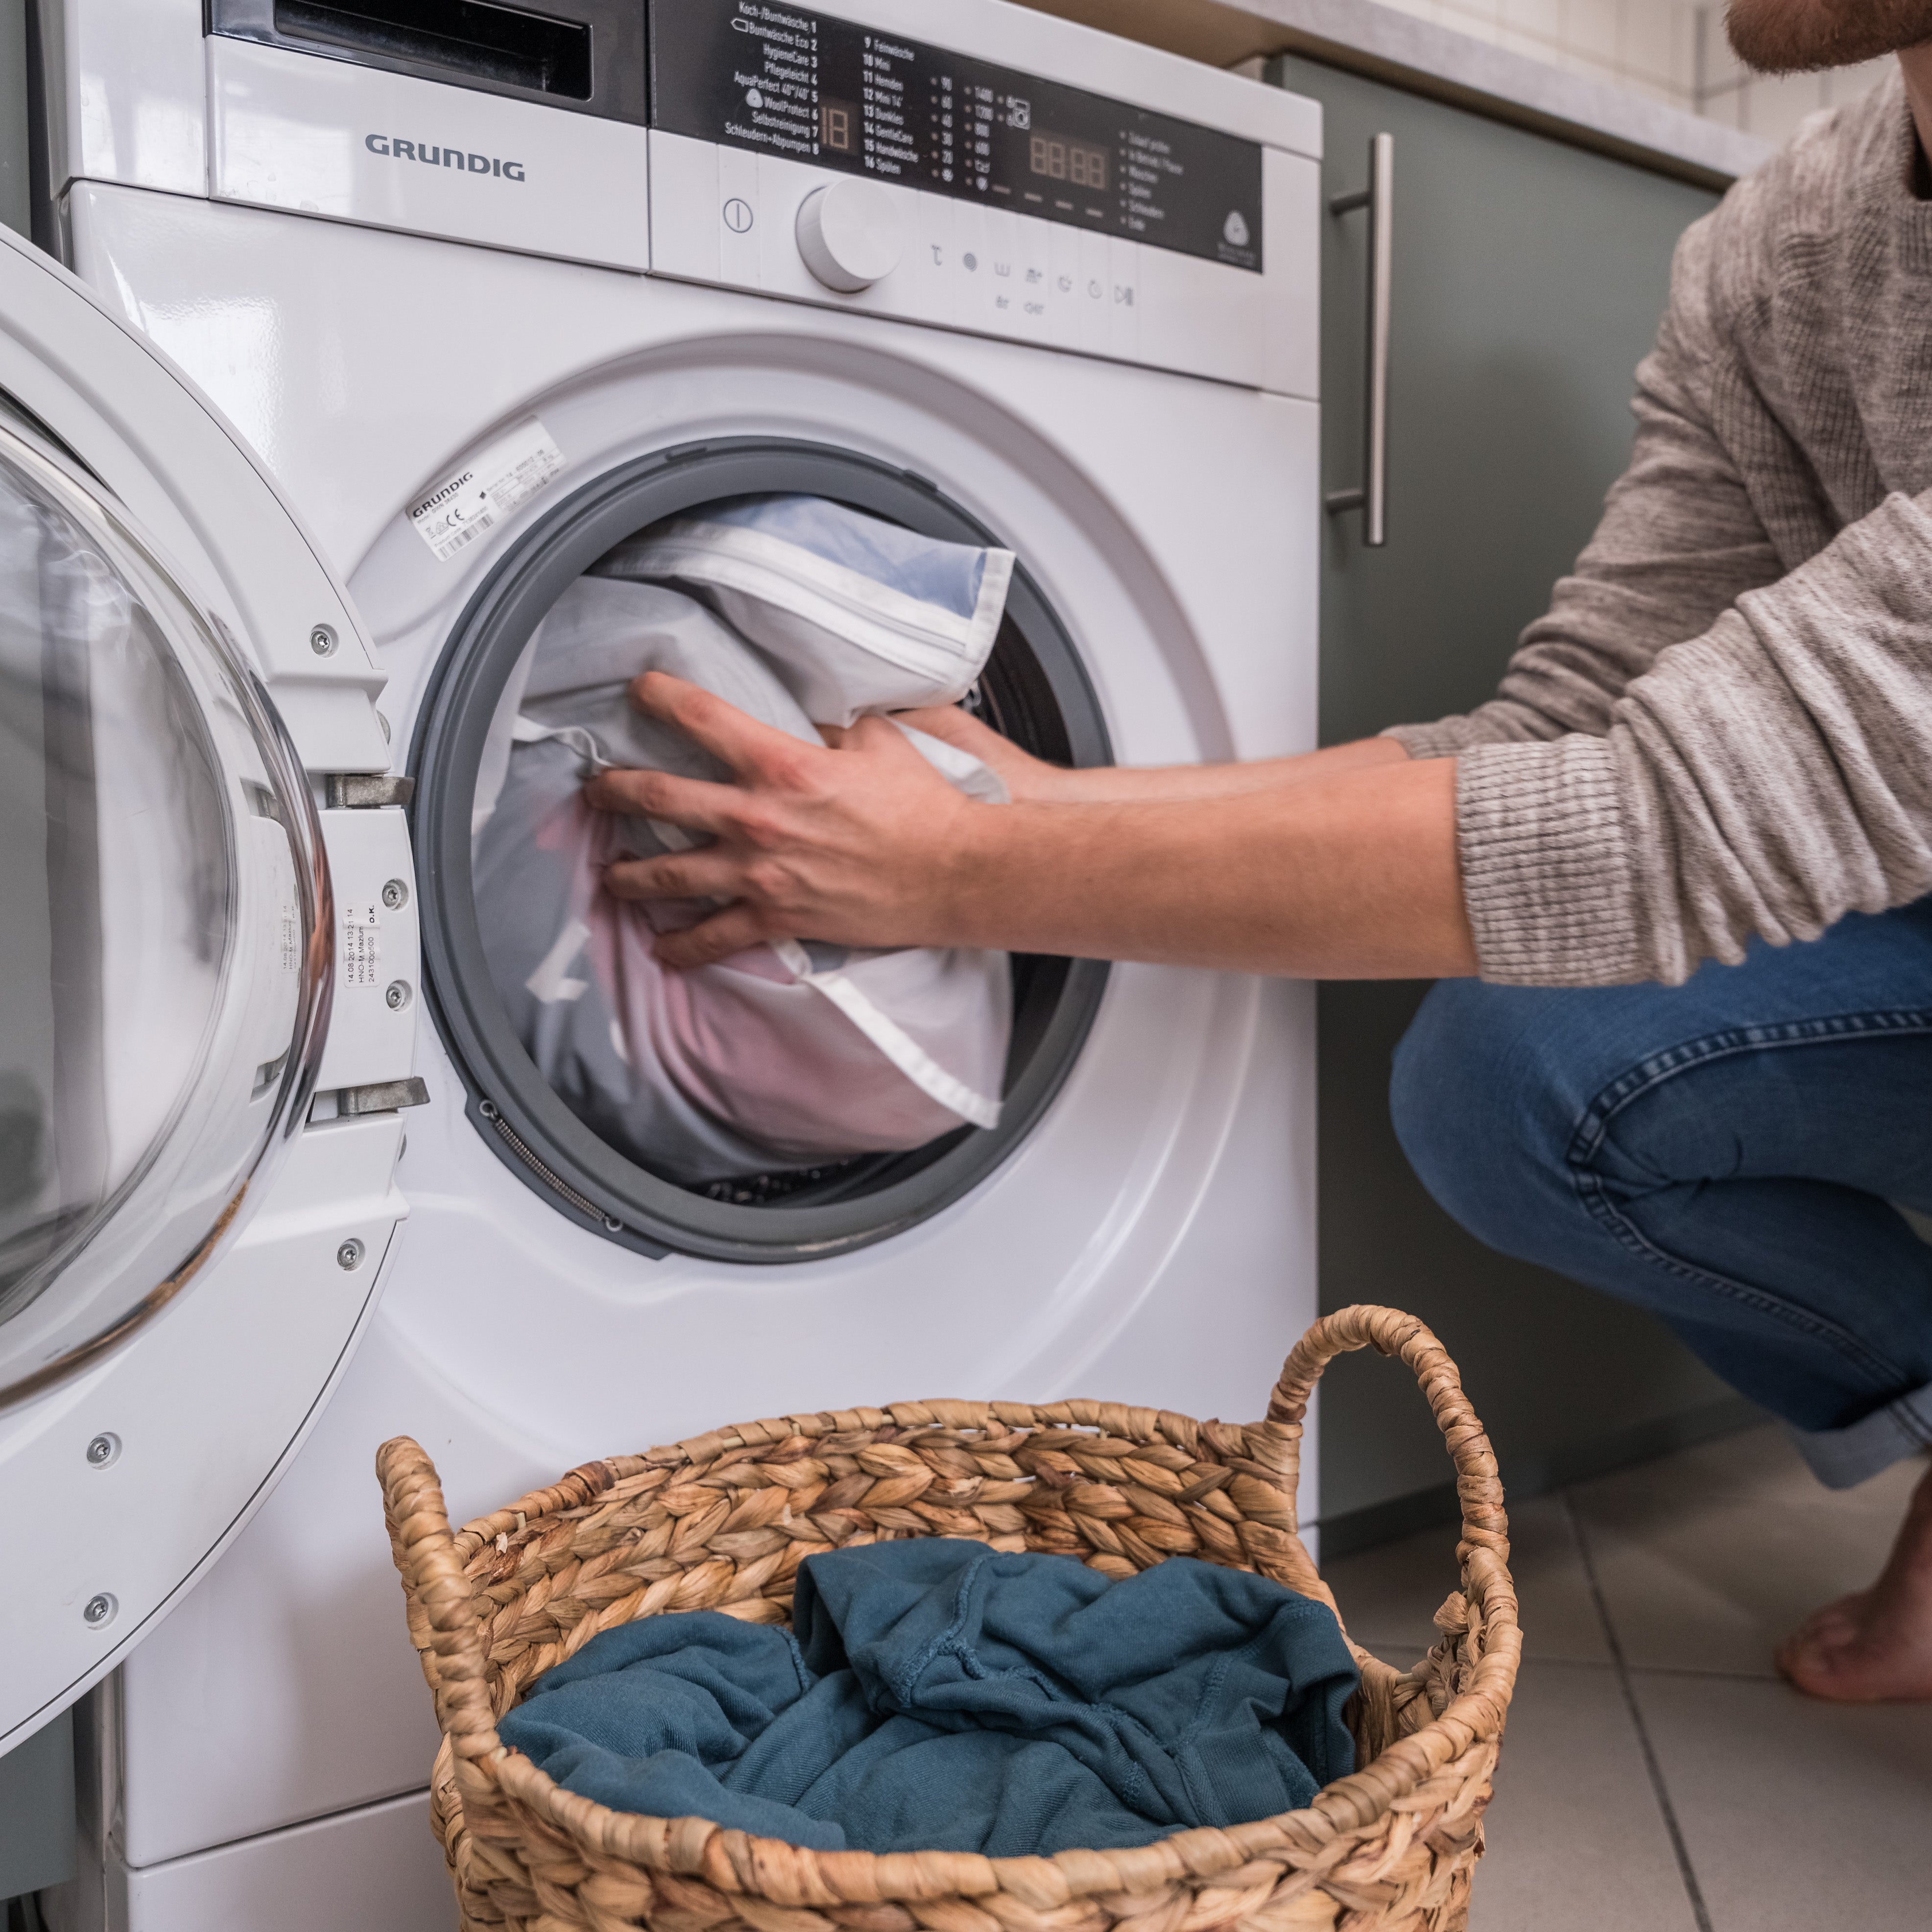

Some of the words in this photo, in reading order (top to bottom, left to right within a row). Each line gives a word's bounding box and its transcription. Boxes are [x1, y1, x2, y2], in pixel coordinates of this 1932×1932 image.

[811, 21, 817, 33] 1
[811, 38, 817, 51] 2
[811, 55, 817, 68] 3
[811, 74, 818, 86] 4
[862, 70, 873, 84] 11
[811, 90, 818, 103] 5
[862, 86, 874, 100] 12
[811, 108, 818, 120] 6
[811, 125, 818, 138] 7
[863, 121, 875, 135] 14
[812, 142, 819, 155] 8
[365, 134, 525, 182] GRUNDIG
[413, 471, 474, 518] GRUNDIG
